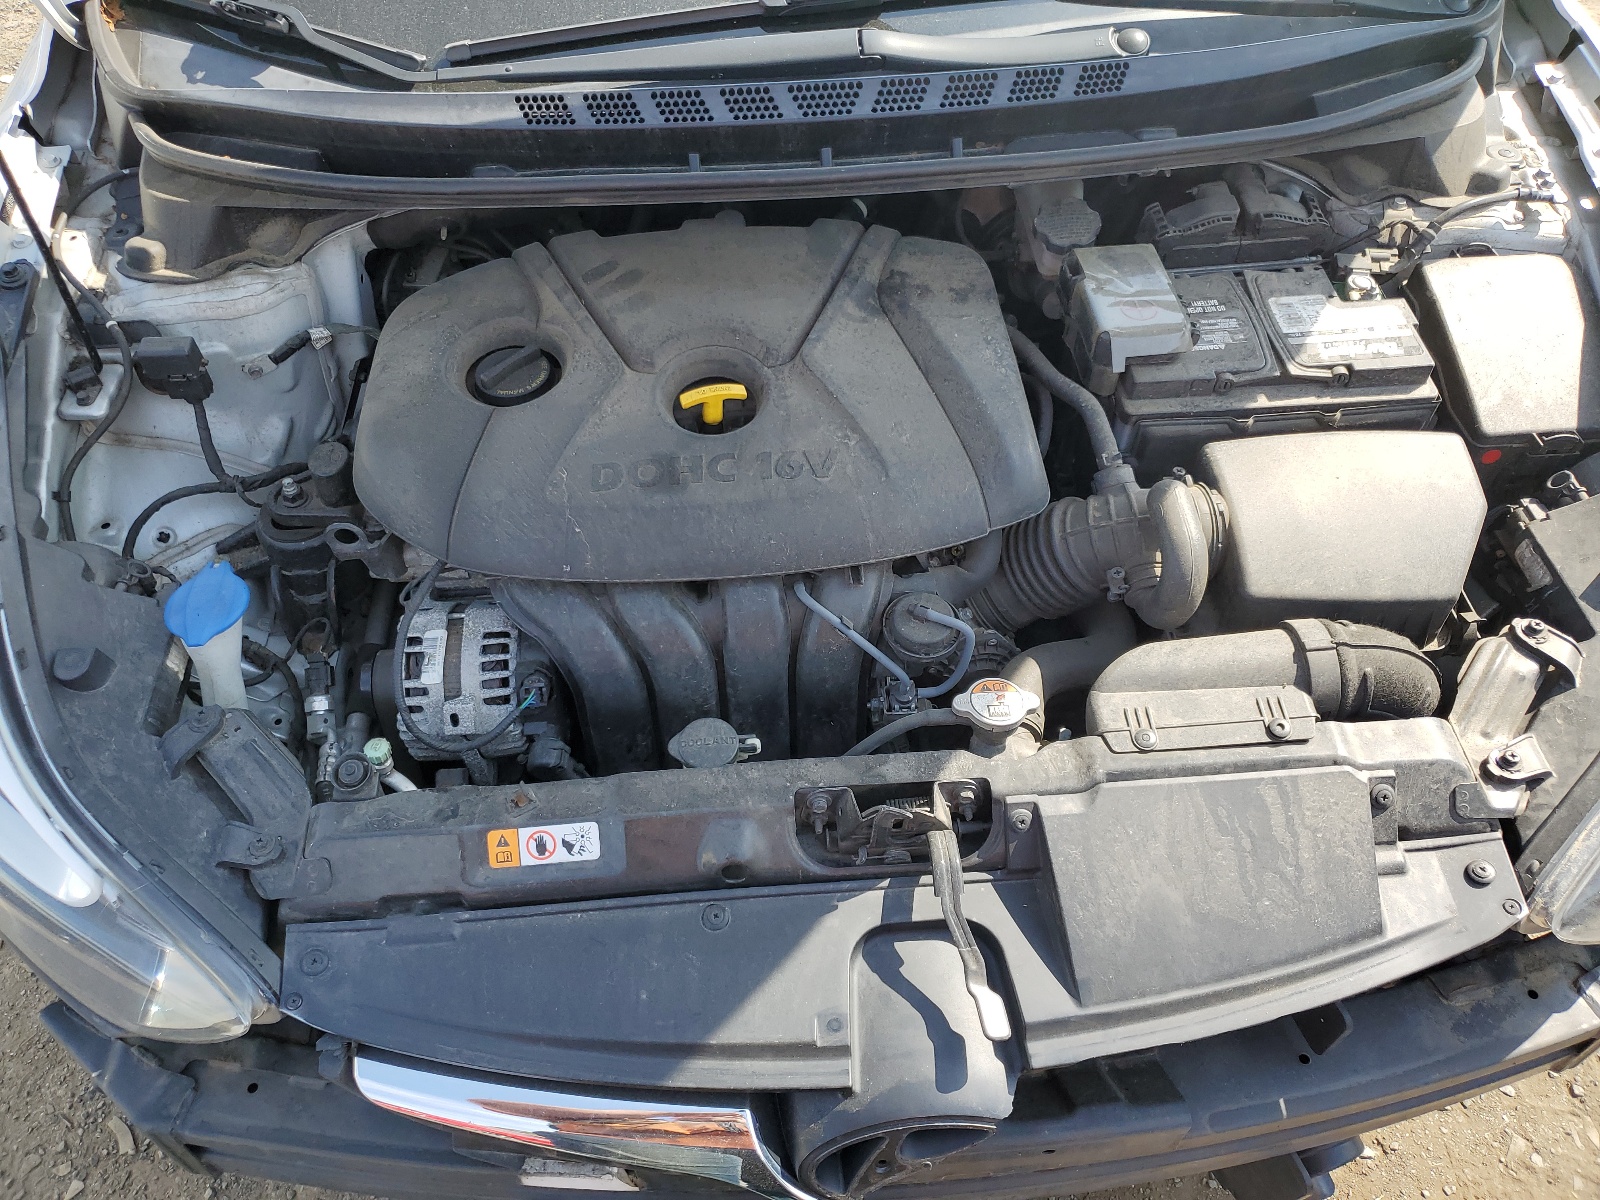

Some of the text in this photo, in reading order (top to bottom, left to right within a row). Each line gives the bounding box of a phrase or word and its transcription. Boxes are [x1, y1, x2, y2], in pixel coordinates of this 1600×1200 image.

[591, 449, 832, 493] DOHC 16V
[681, 736, 736, 748] COOLANT
